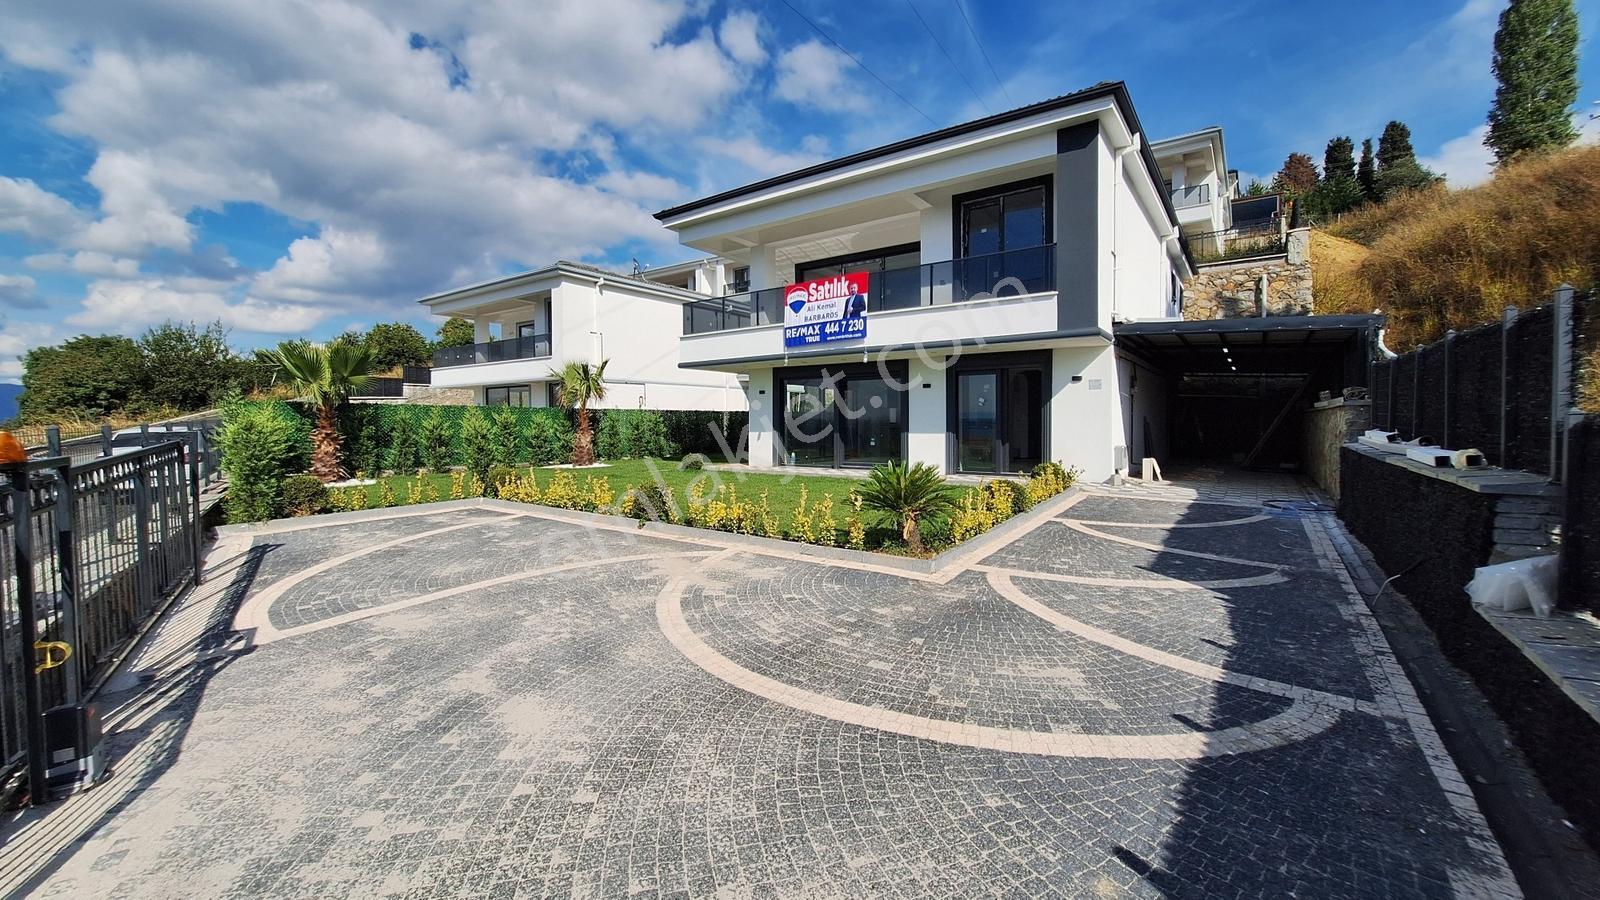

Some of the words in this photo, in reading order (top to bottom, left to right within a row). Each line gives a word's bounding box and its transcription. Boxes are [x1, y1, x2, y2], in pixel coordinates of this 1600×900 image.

[808, 276, 850, 302] Satılık
[816, 302, 837, 310] Kemal
[785, 325, 820, 339] RE/MAX
[824, 321, 840, 335] 444
[841, 320, 847, 333] 7
[848, 318, 864, 332] 230
[805, 335, 821, 343] TRUE
